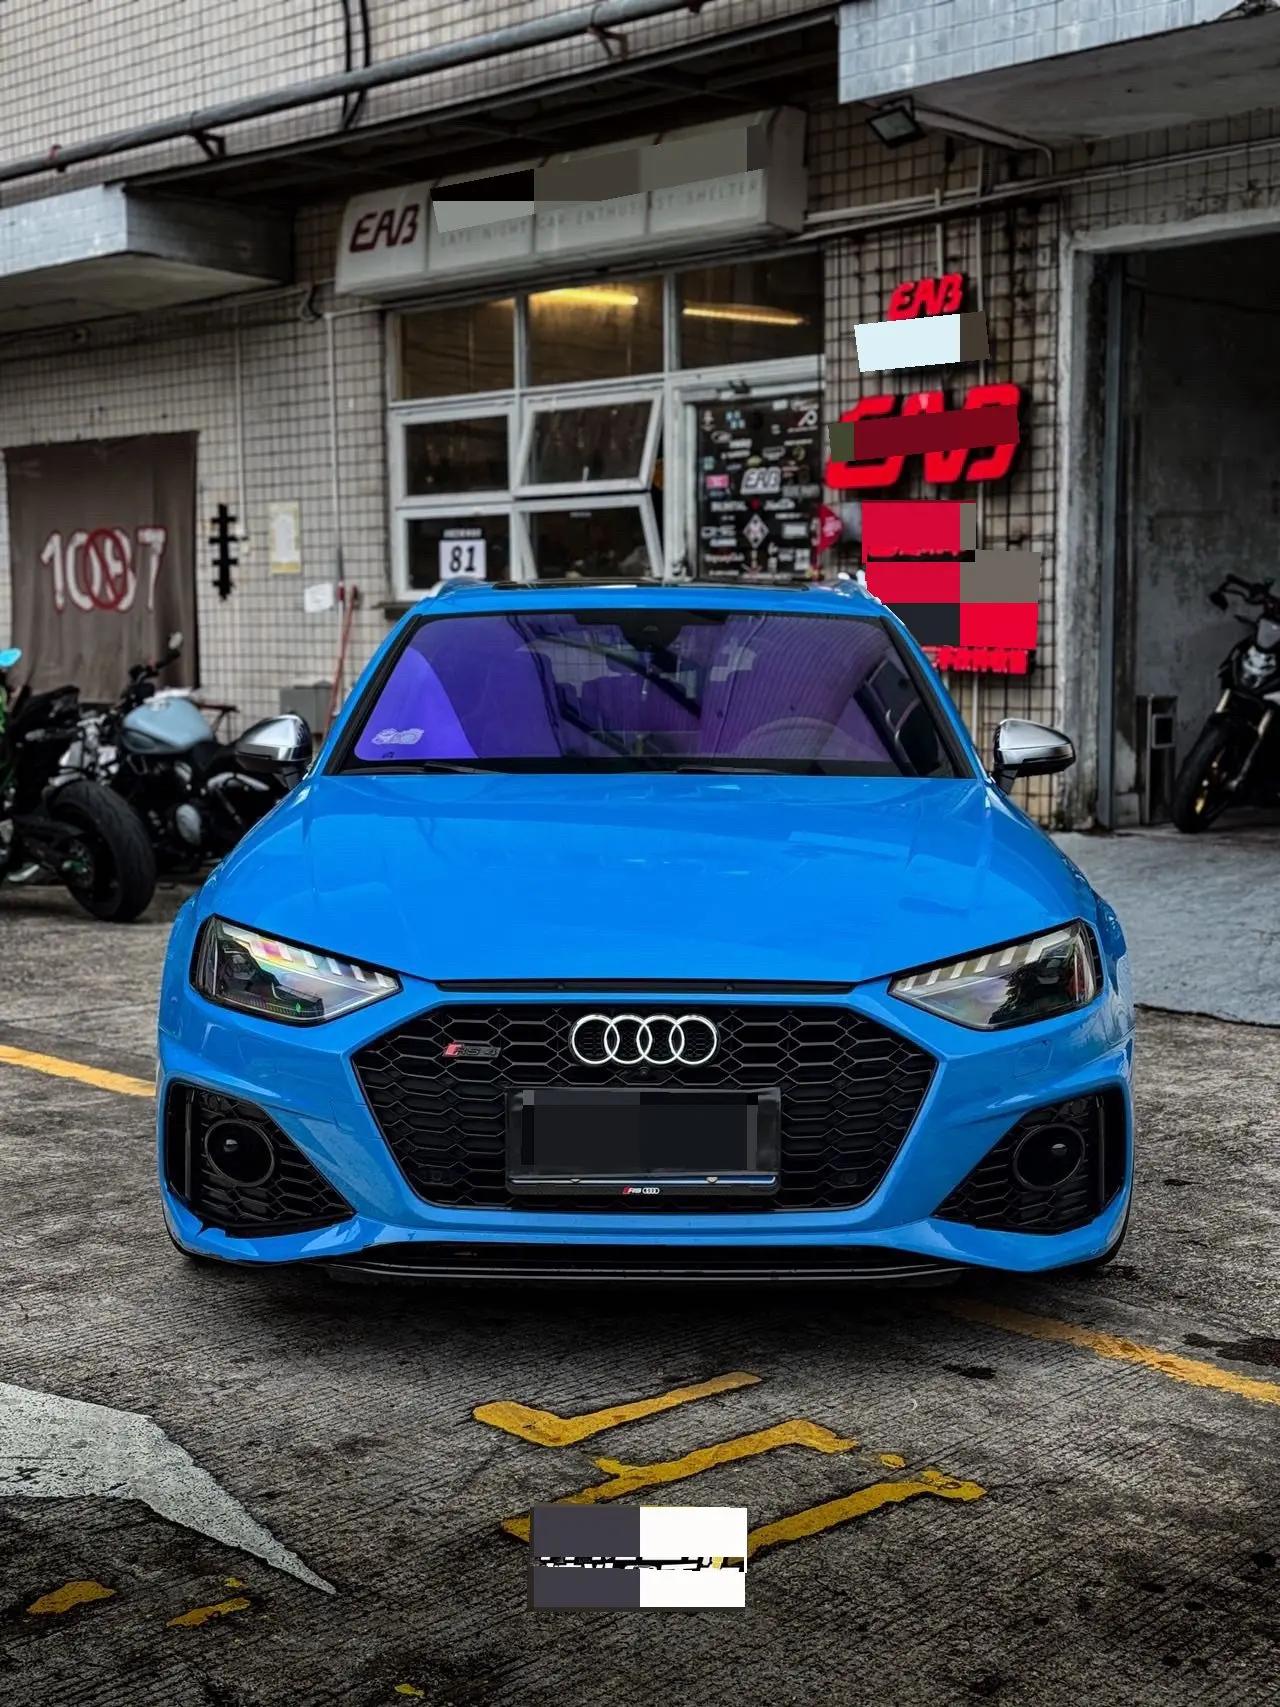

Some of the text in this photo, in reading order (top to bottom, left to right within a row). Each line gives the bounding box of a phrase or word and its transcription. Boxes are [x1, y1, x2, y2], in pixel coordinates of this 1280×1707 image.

[349, 203, 419, 253] EAB
[886, 272, 964, 321] EAB
[449, 545, 475, 573] 81
